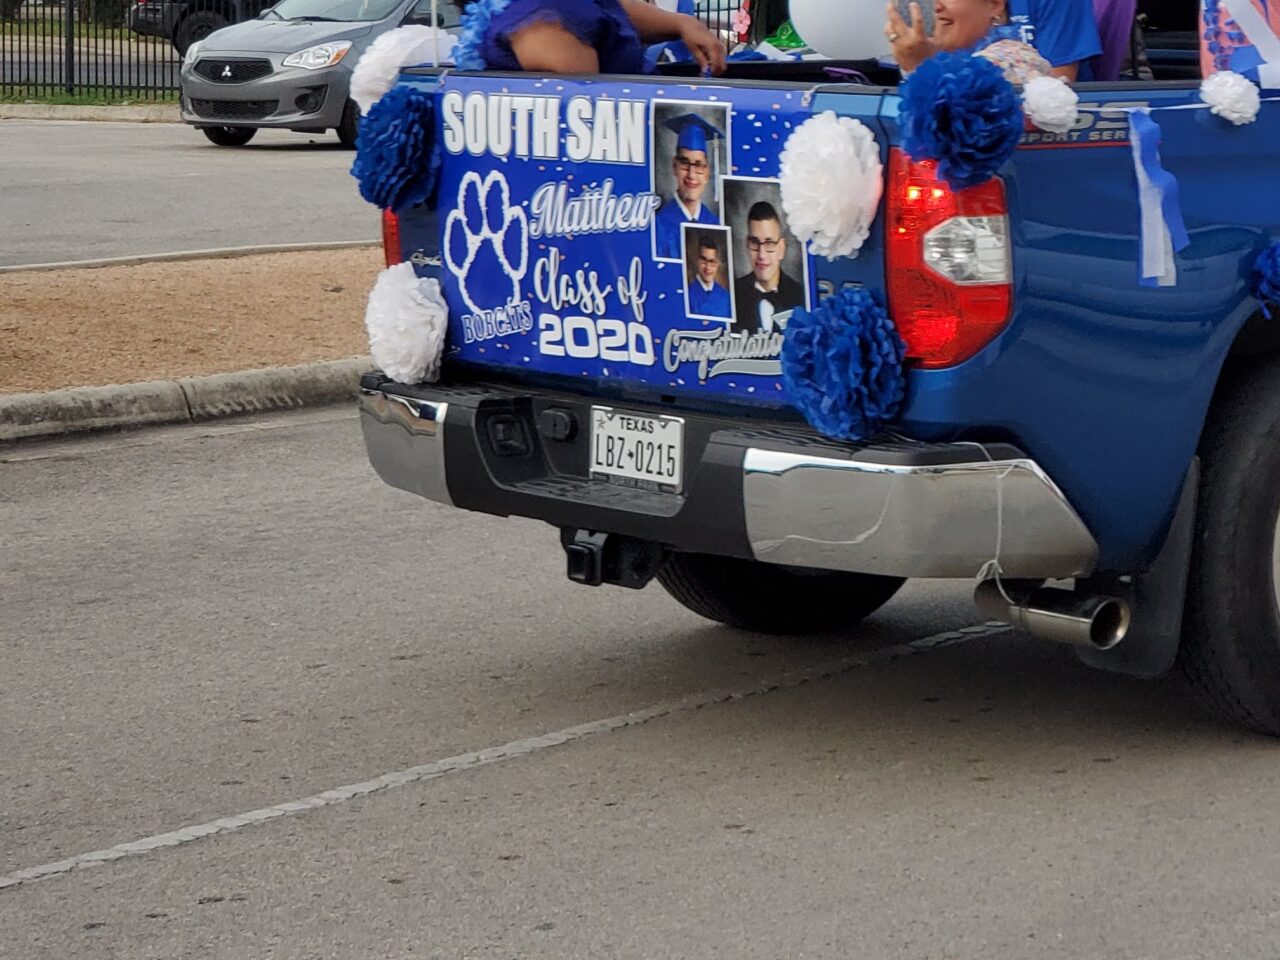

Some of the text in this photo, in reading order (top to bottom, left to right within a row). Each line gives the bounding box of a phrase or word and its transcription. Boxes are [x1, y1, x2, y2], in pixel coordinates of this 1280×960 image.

[441, 90, 648, 166] SOUTH SAN
[1087, 130, 1128, 141] SER
[530, 178, 662, 239] Matthew
[533, 246, 648, 323] Class of
[461, 298, 533, 344] BOBCATS
[539, 313, 656, 367] 2020
[663, 327, 785, 380] Congratulatio
[619, 416, 654, 434] TEXAS
